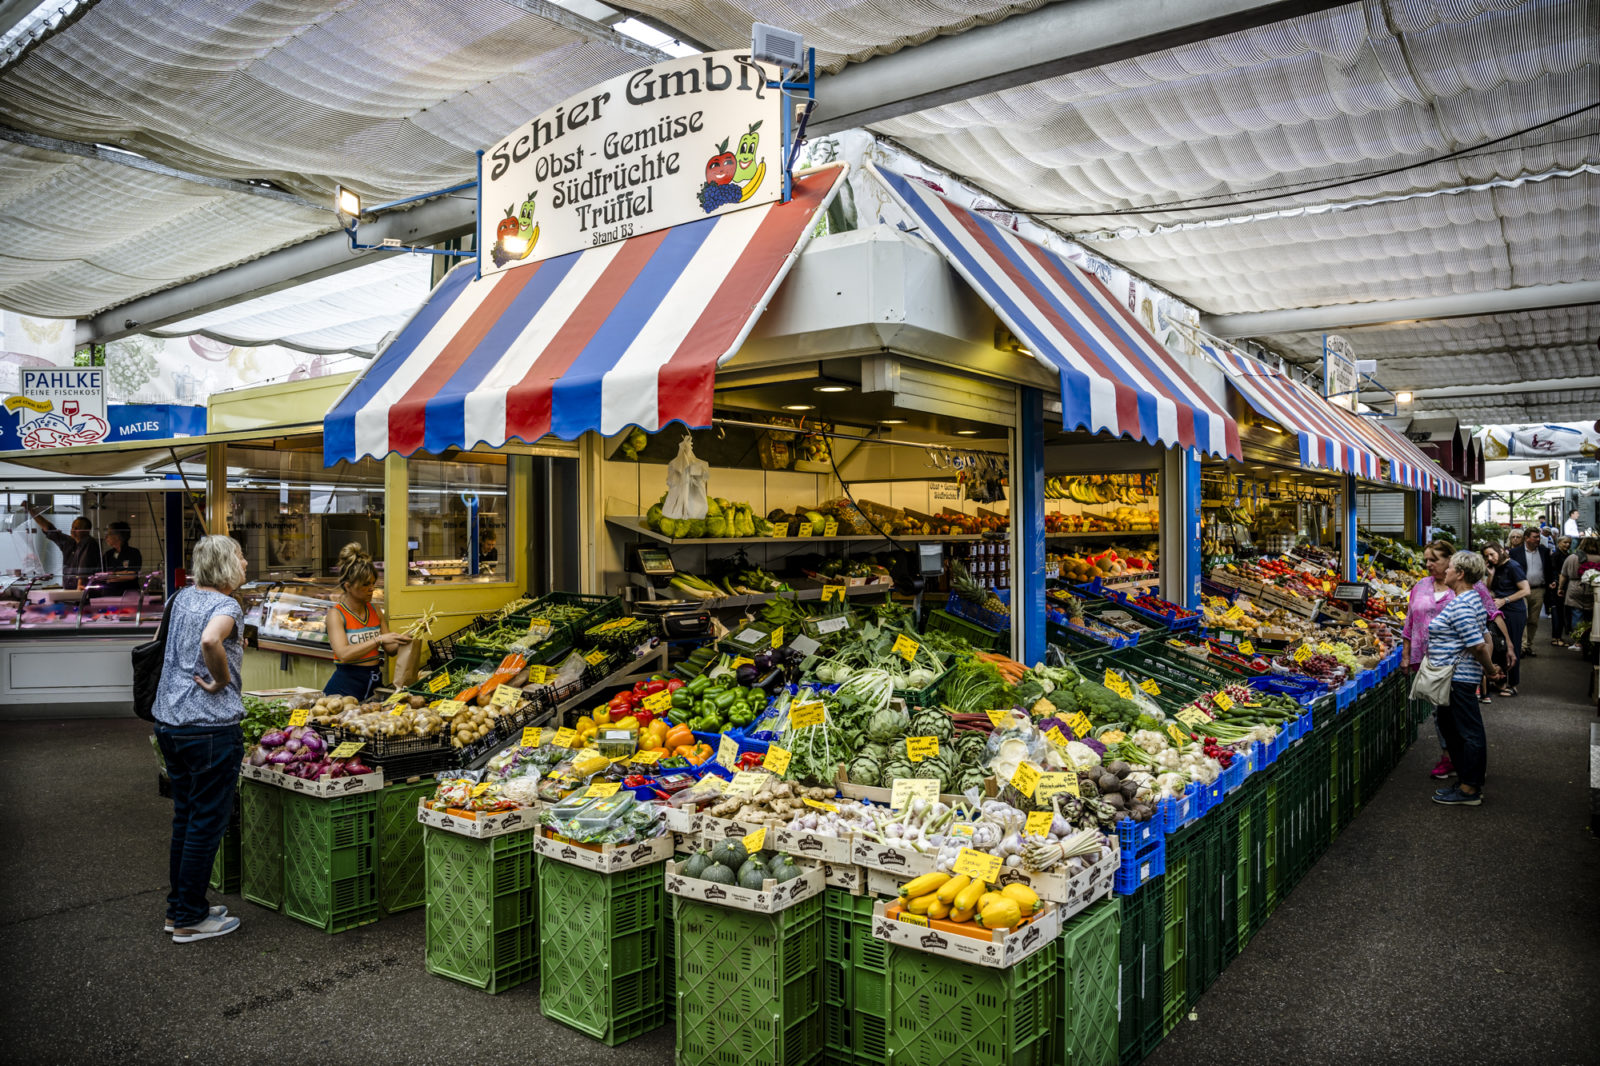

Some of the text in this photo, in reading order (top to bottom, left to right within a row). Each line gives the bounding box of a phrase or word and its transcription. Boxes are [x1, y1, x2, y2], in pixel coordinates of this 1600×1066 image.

[490, 54, 767, 182] Schier GmbH
[535, 144, 586, 183] Obst
[603, 110, 704, 160] Gemüse
[552, 151, 681, 209] Südfrüchte
[575, 185, 654, 232] Trüffel
[592, 223, 634, 246] Stand B3
[25, 372, 101, 388] PAHLKE
[119, 421, 159, 436] MATJES
[1534, 467, 1546, 480] B
